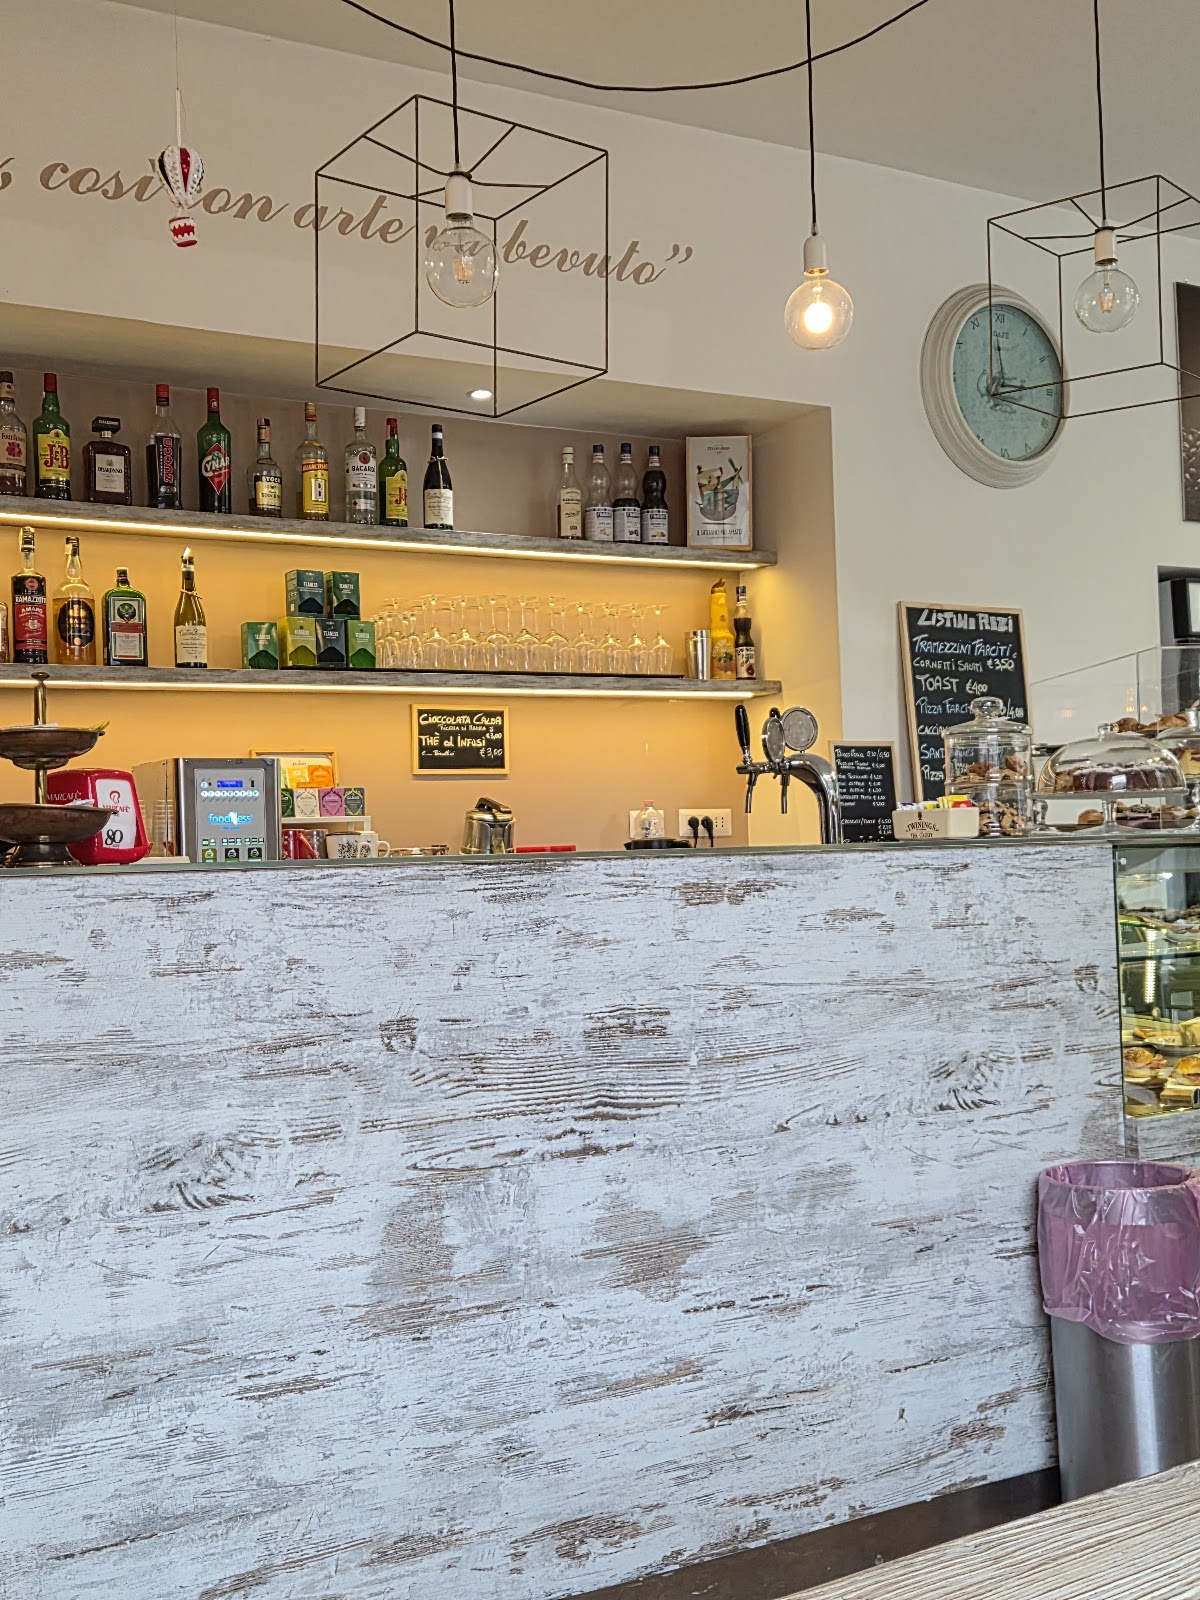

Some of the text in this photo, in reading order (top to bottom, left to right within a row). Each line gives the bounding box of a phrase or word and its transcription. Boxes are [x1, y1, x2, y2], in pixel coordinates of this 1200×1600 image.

[293, 195, 415, 244] arte
[163, 438, 173, 483] ZUCCA
[202, 456, 230, 477] CYNAR
[915, 674, 960, 693] TOAST
[916, 697, 942, 714] PIZZA
[942, 698, 974, 714] FARCIT
[104, 829, 124, 846] 80
